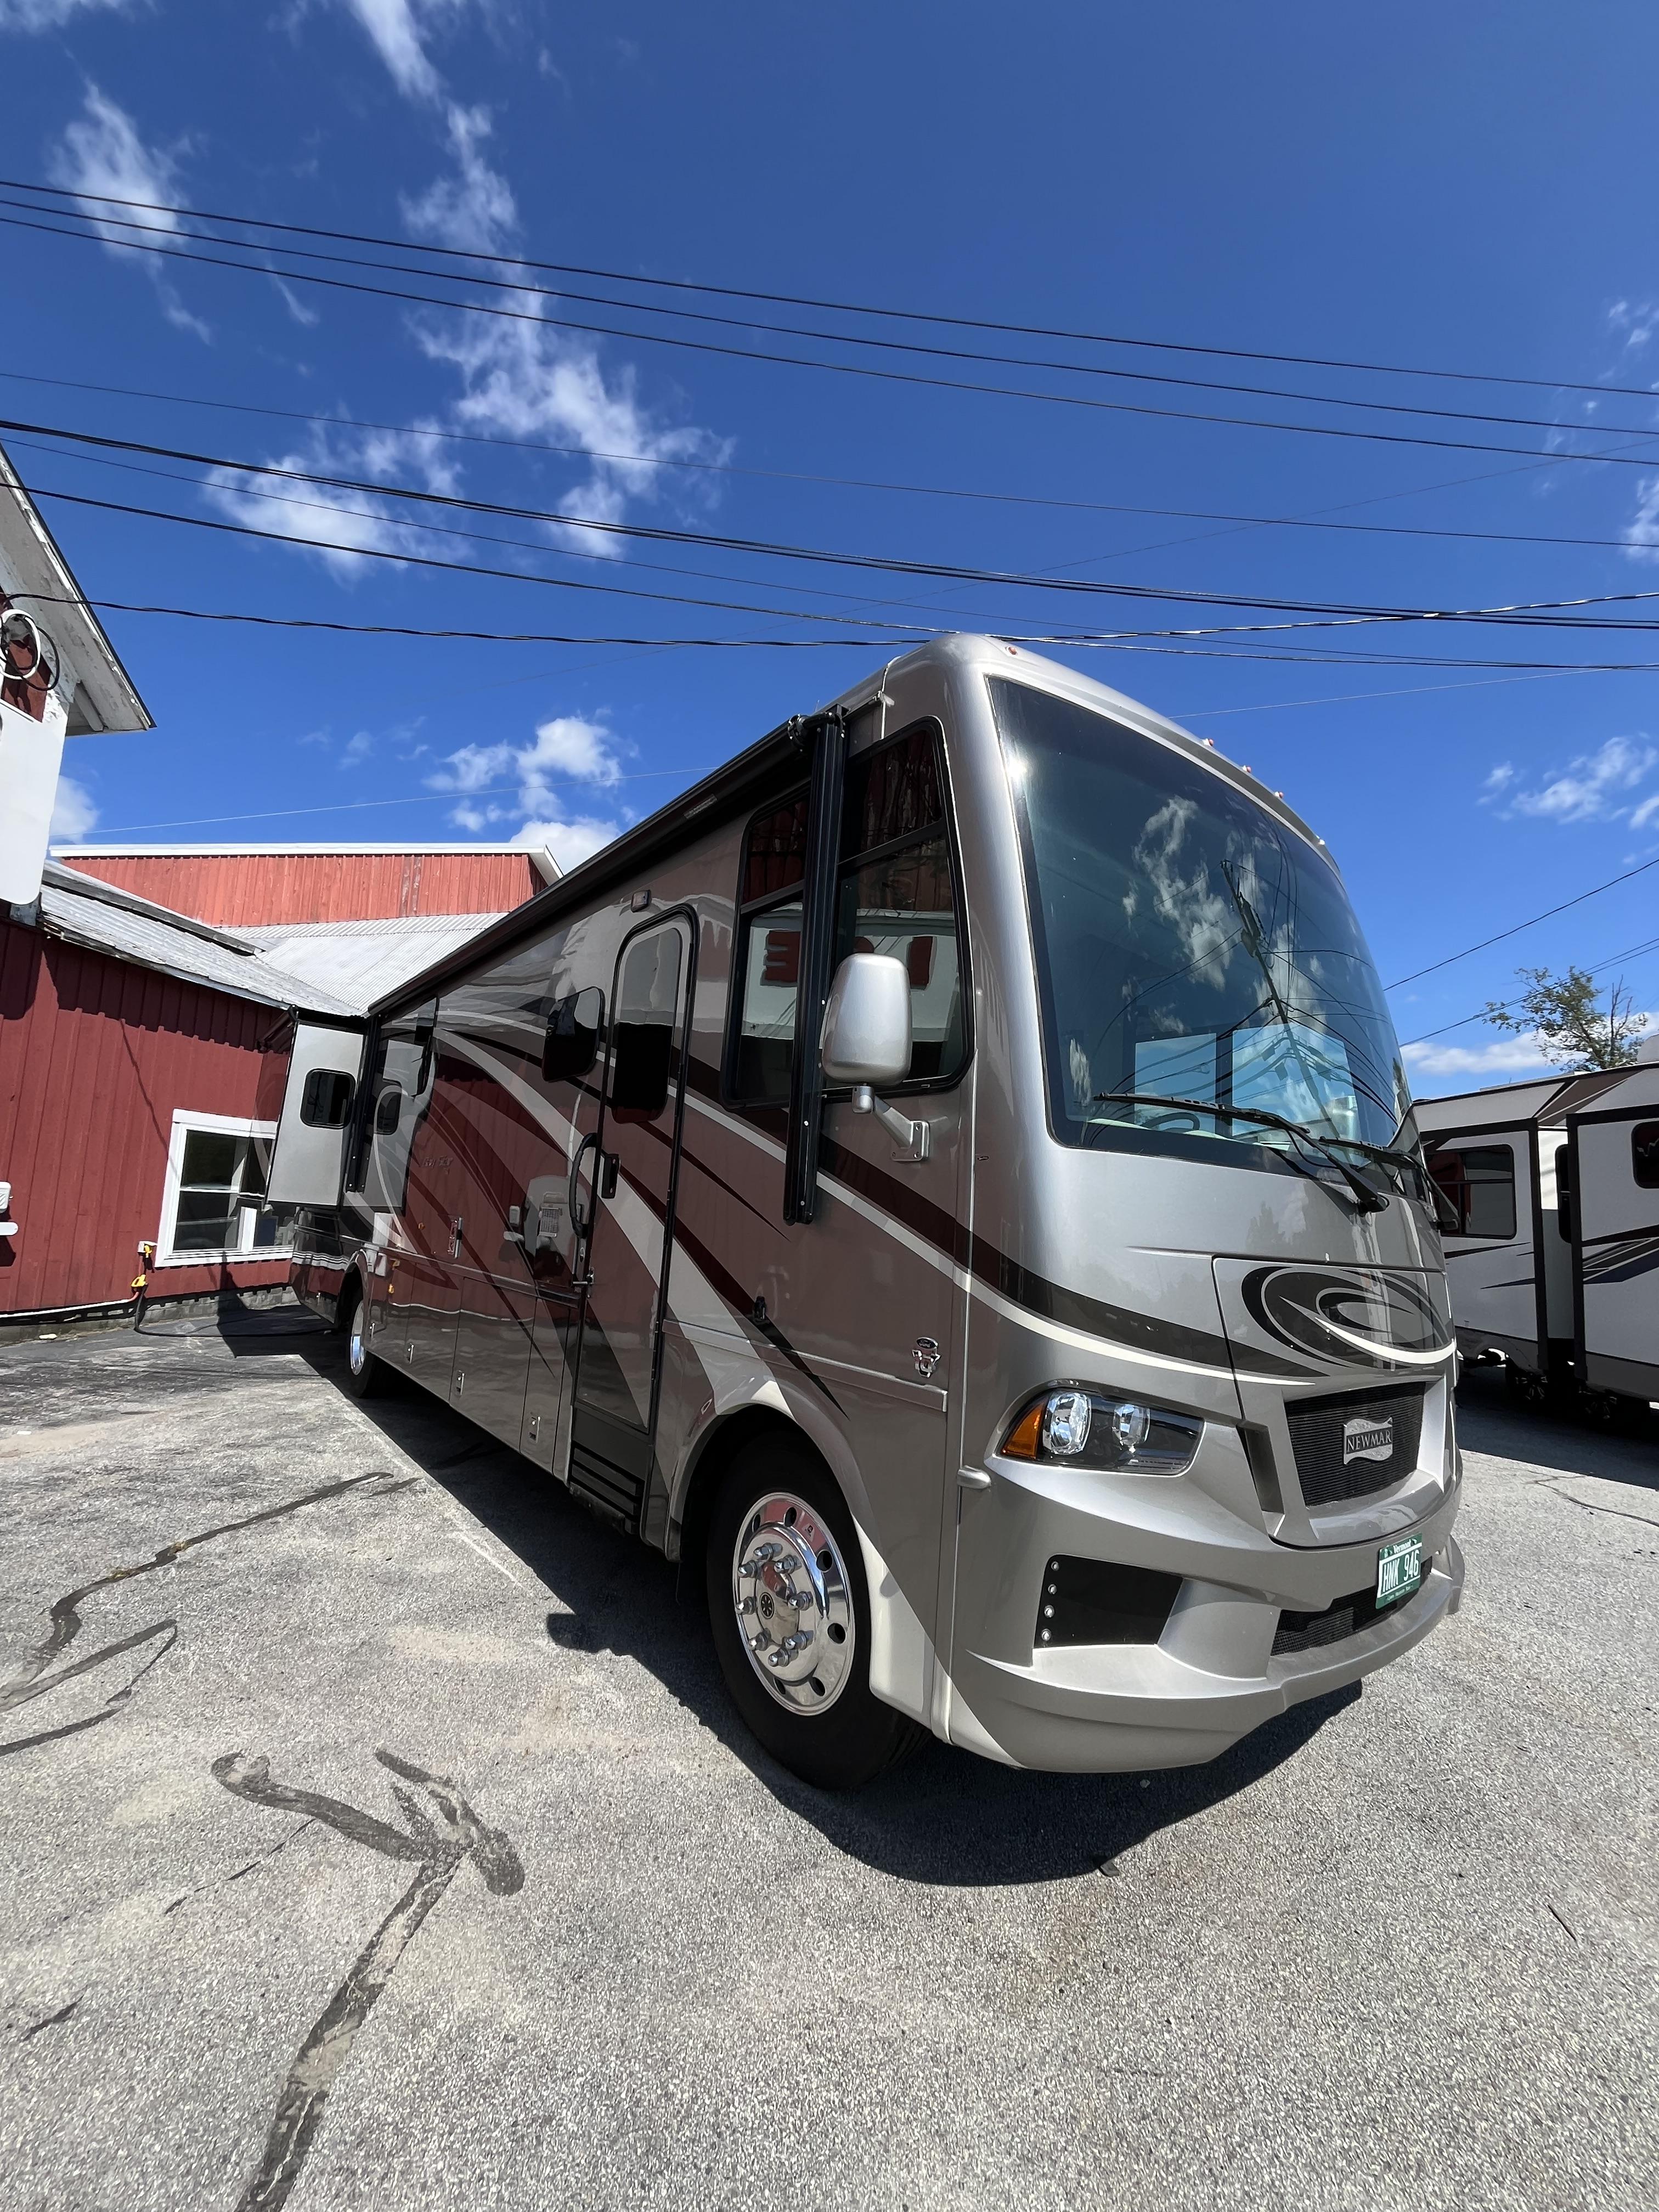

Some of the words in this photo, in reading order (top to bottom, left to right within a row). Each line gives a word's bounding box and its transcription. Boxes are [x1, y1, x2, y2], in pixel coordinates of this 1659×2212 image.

[1347, 1430, 1392, 1453] NEWMAR
[1383, 1558, 1400, 1593] HNK
[1403, 1549, 1420, 1581] 946
